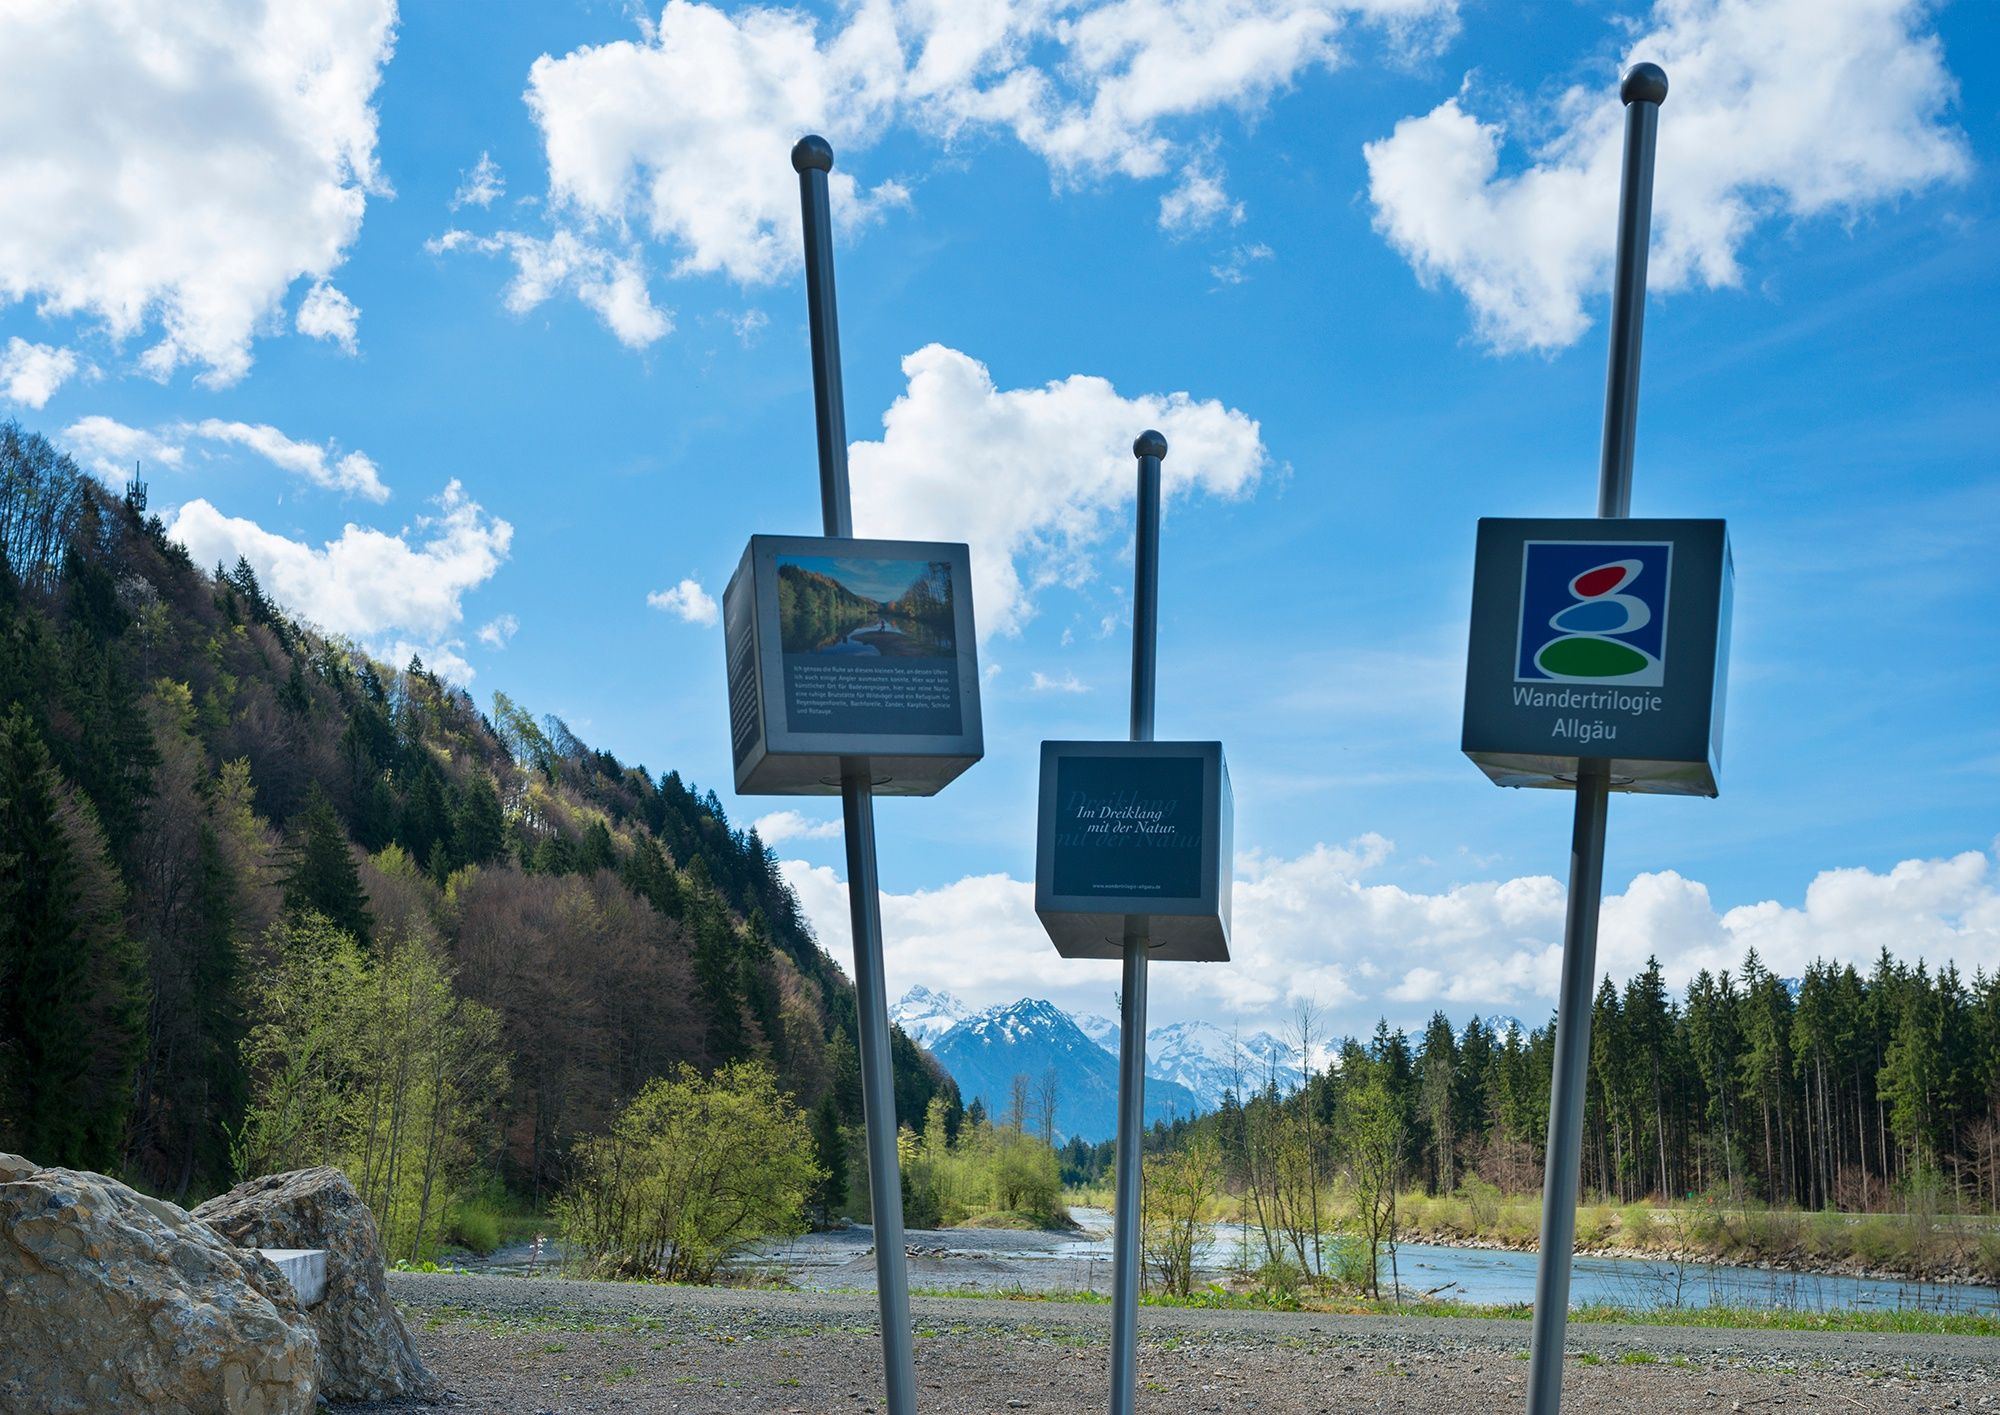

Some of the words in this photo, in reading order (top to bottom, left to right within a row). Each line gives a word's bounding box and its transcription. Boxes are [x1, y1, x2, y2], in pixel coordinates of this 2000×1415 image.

[819, 674, 837, 682] einige
[838, 675, 856, 683] Angler
[848, 684, 892, 692] Badevergnügen,
[808, 691, 826, 699] ruhige
[1512, 686, 1663, 716] Wandertrilogie
[796, 699, 849, 707] Regenbogenforelle,
[906, 702, 930, 710] Karpfen,
[1551, 717, 1618, 744] Allgäu
[1076, 805, 1096, 819] Im
[1098, 805, 1163, 823] Dreiklang
[1086, 820, 1110, 833] mit
[1112, 819, 1133, 833] der
[1134, 820, 1176, 834] Natur.
